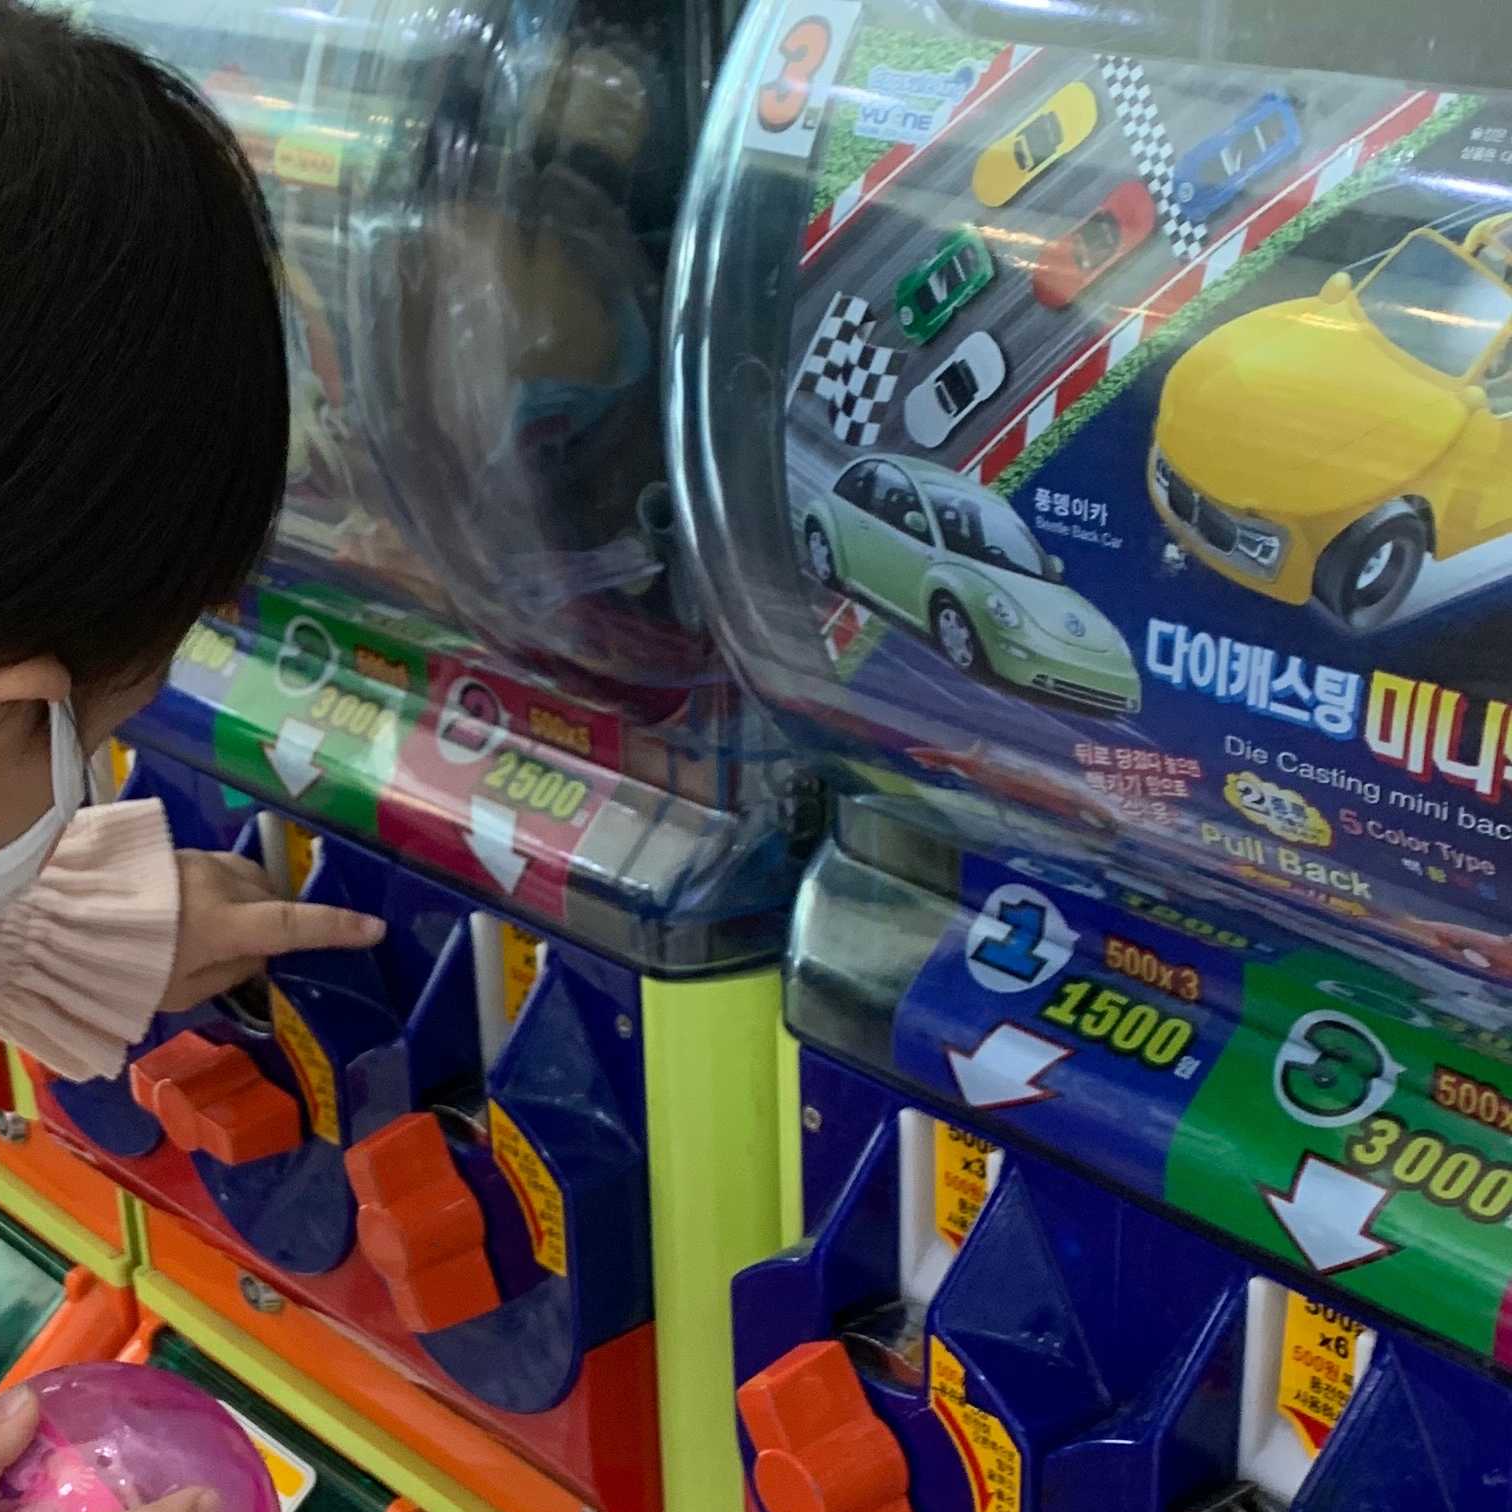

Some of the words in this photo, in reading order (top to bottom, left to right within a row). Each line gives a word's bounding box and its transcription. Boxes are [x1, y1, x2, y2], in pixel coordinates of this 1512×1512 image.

[756, 15, 831, 133] 3
[1034, 487, 1108, 527] 풍뎅이카
[1146, 617, 1365, 742] 다이캐스팅
[1224, 734, 1269, 765] Die
[1276, 751, 1381, 803] Casting
[1388, 790, 1449, 821] mini
[1200, 821, 1265, 866] Pull
[1277, 846, 1373, 899] Back
[1339, 807, 1364, 836] 5
[1367, 819, 1431, 855] Color
[1434, 840, 1498, 876] Type
[968, 898, 1050, 985] 1
[1280, 1018, 1385, 1118] 3
[1319, 1333, 1349, 1359] x6
